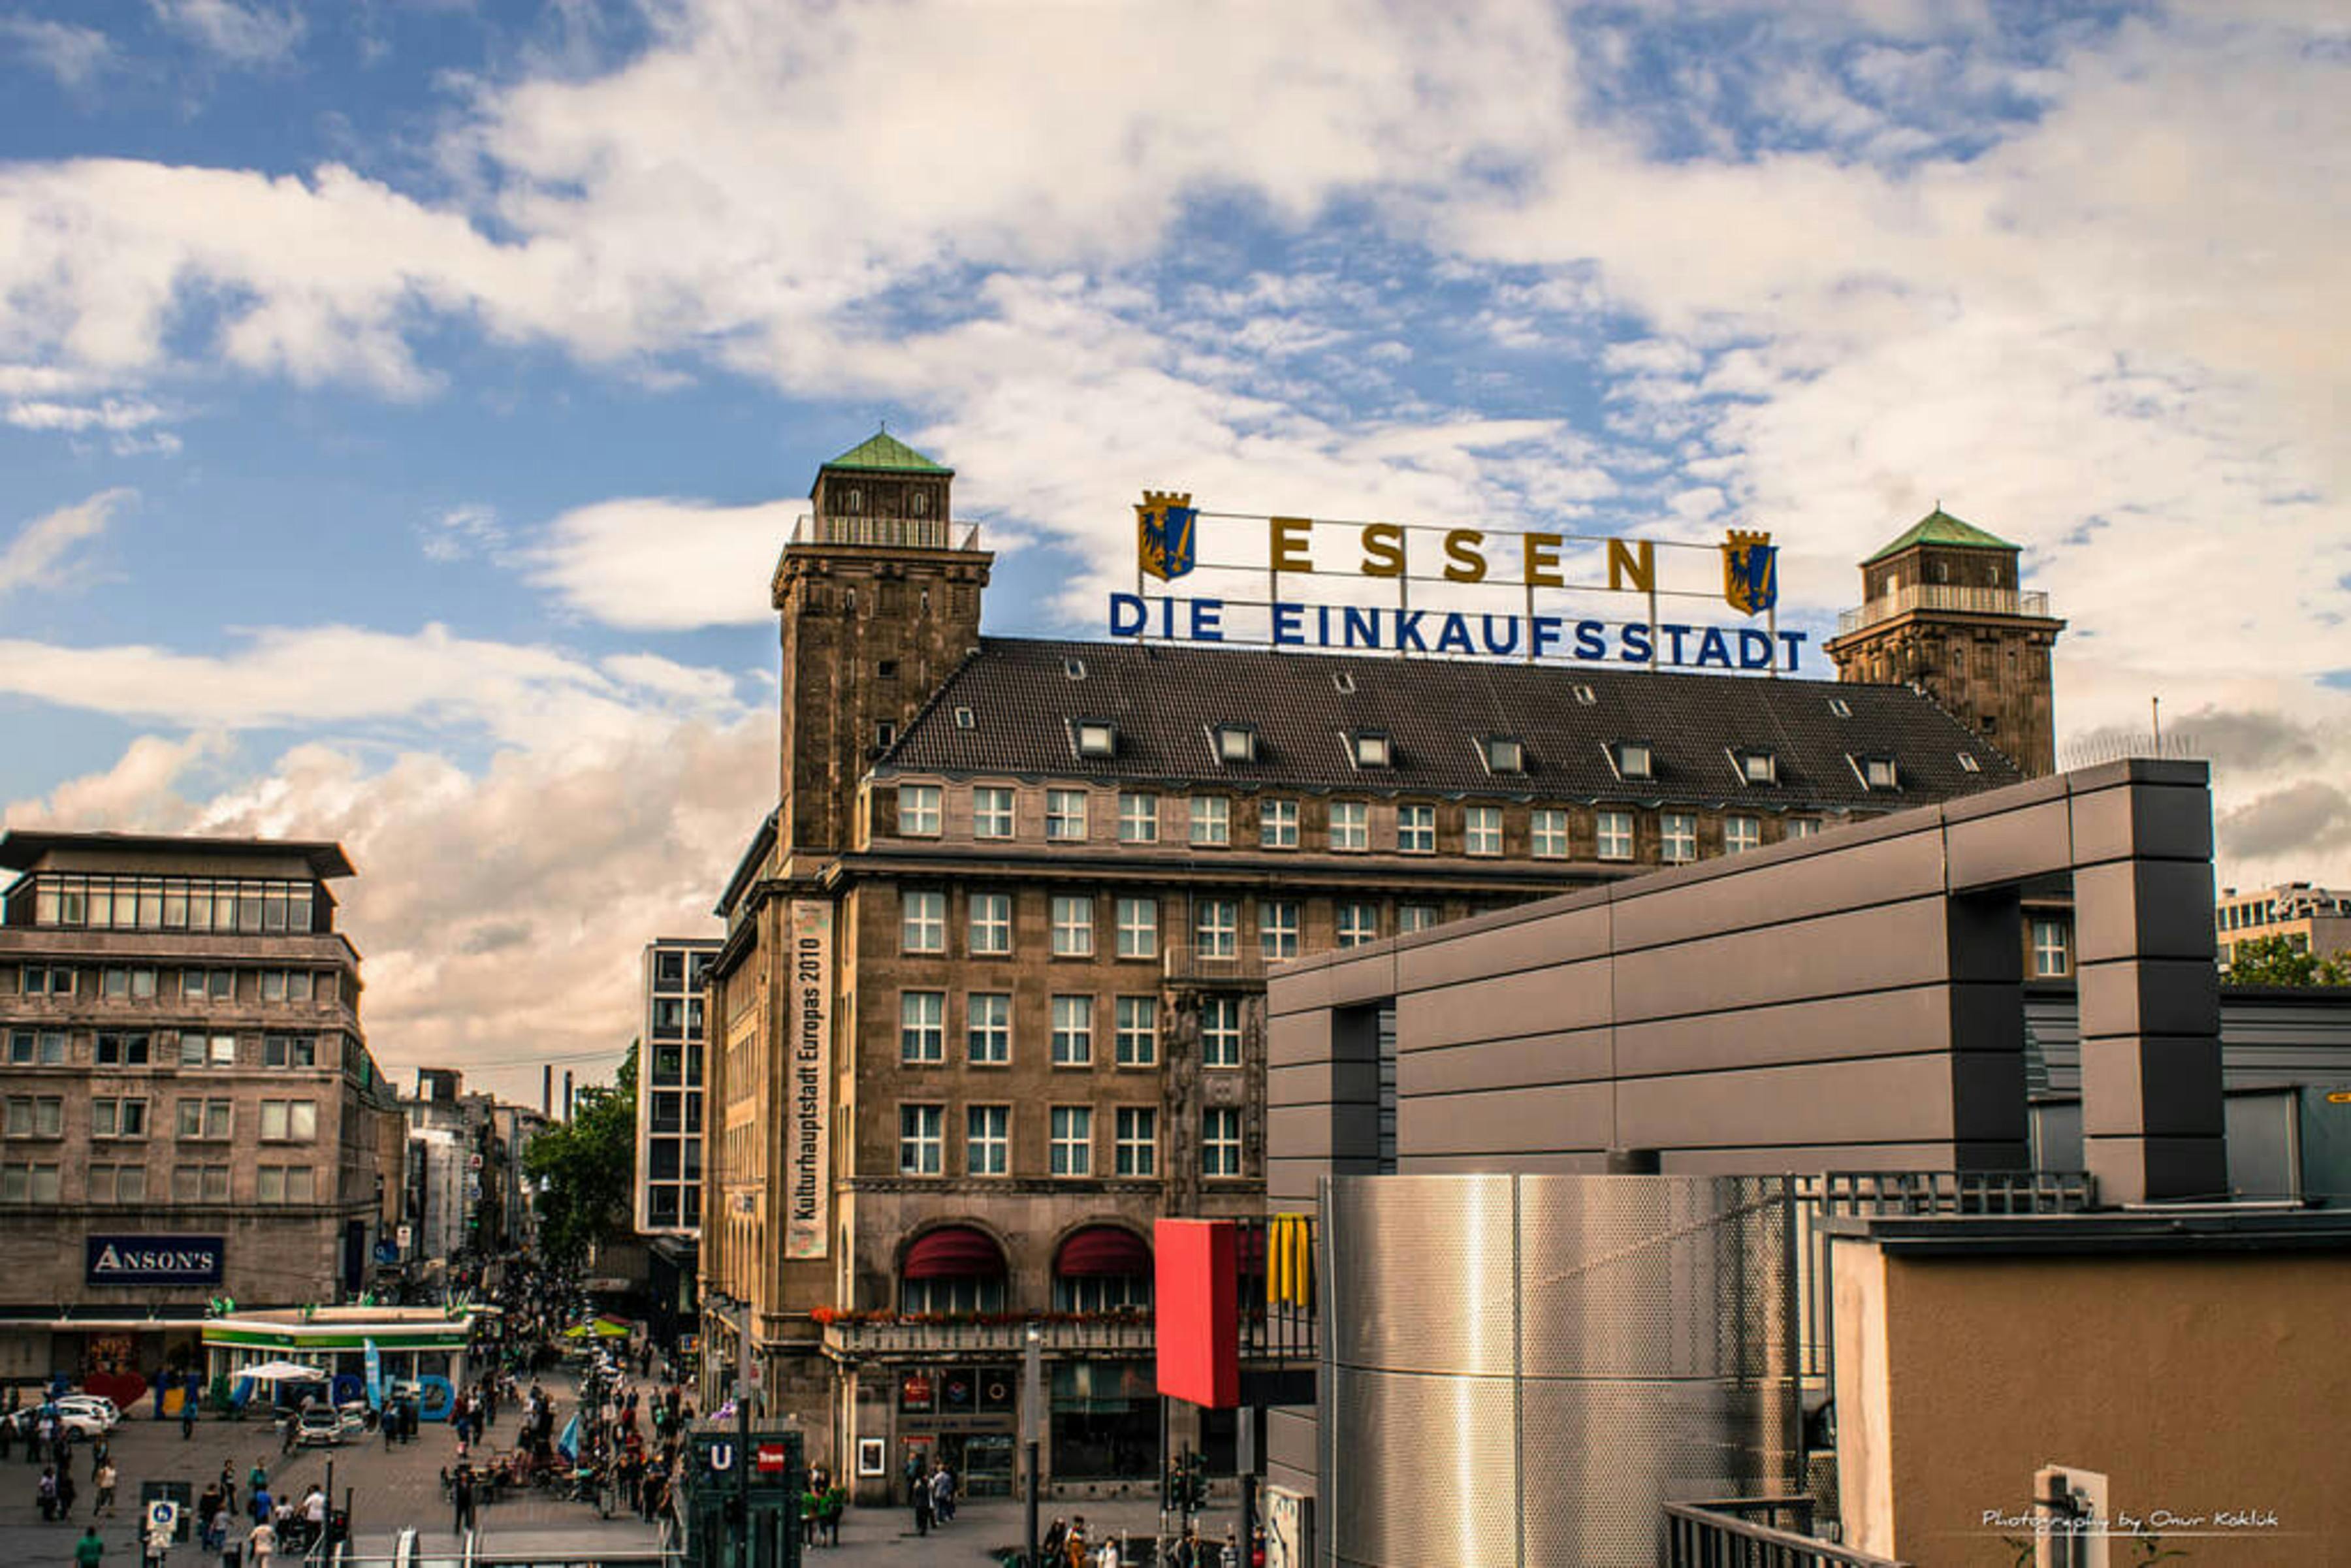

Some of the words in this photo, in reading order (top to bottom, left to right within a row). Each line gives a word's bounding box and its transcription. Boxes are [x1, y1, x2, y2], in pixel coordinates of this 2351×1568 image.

[1270, 517, 1654, 592] ESSEN
[1110, 592, 1224, 643] DIE
[1272, 602, 1808, 671] EINKAUFSSTADT
[798, 938, 820, 982] 2010
[797, 987, 825, 1061] Europas
[793, 1067, 824, 1221] Kulturhauptstadt
[711, 1444, 731, 1470] U
